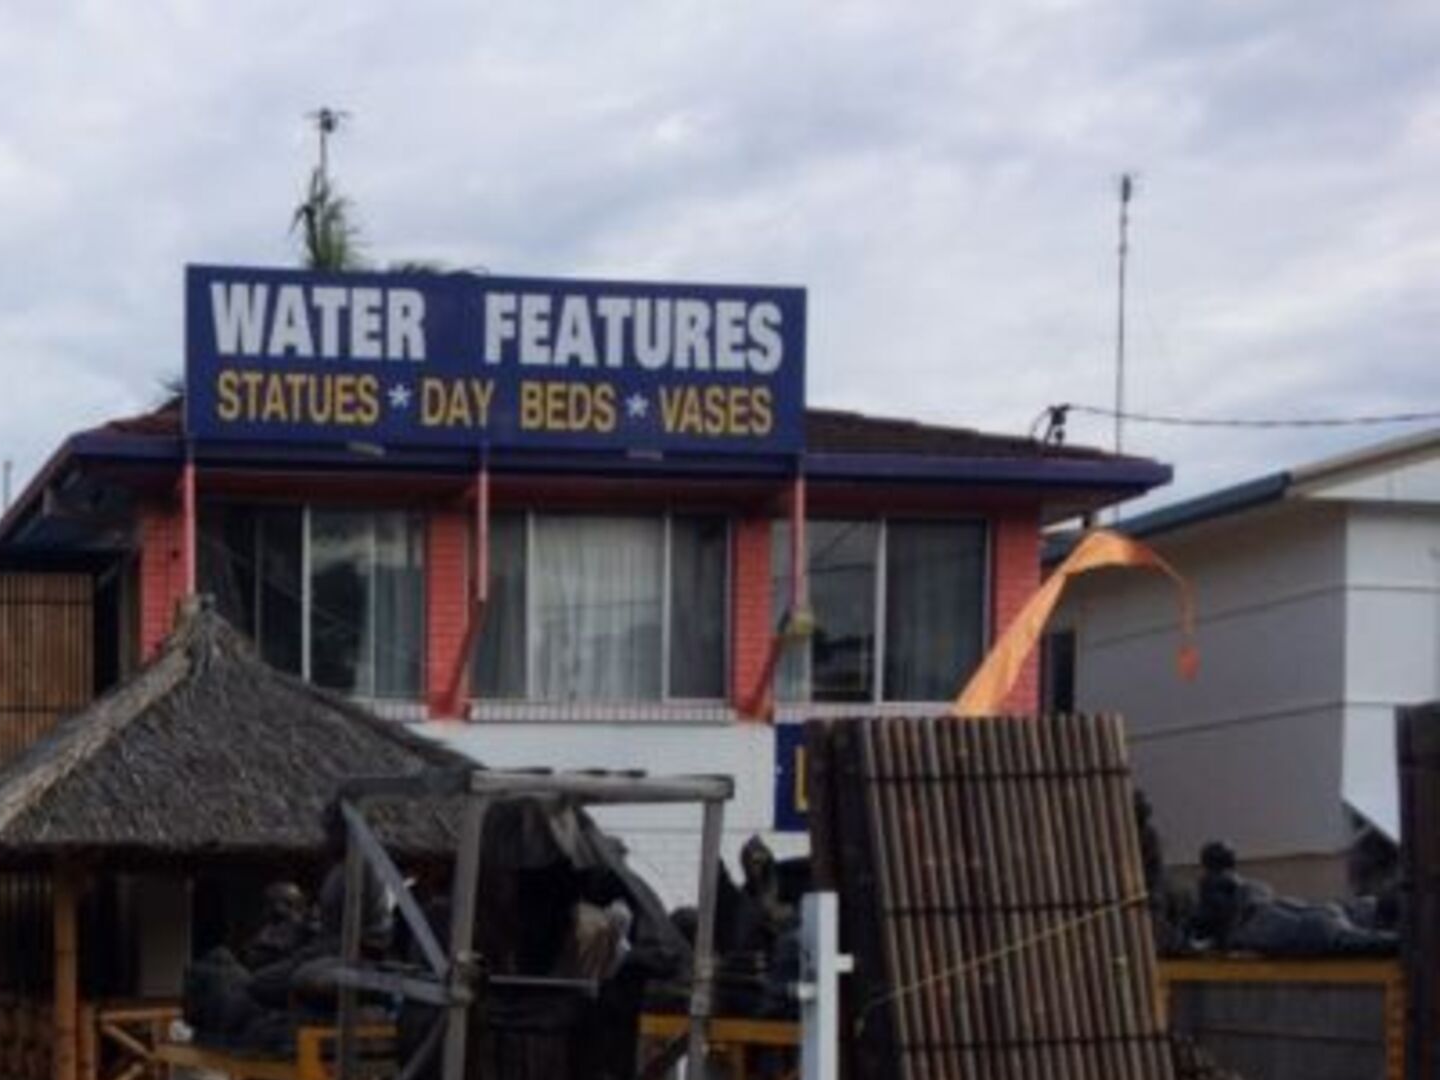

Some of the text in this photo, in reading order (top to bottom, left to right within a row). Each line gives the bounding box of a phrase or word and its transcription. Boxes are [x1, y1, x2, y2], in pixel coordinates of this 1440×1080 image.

[209, 282, 784, 373] WATER FEATURES
[216, 370, 773, 434] STATUES DAY BEDS VASES
